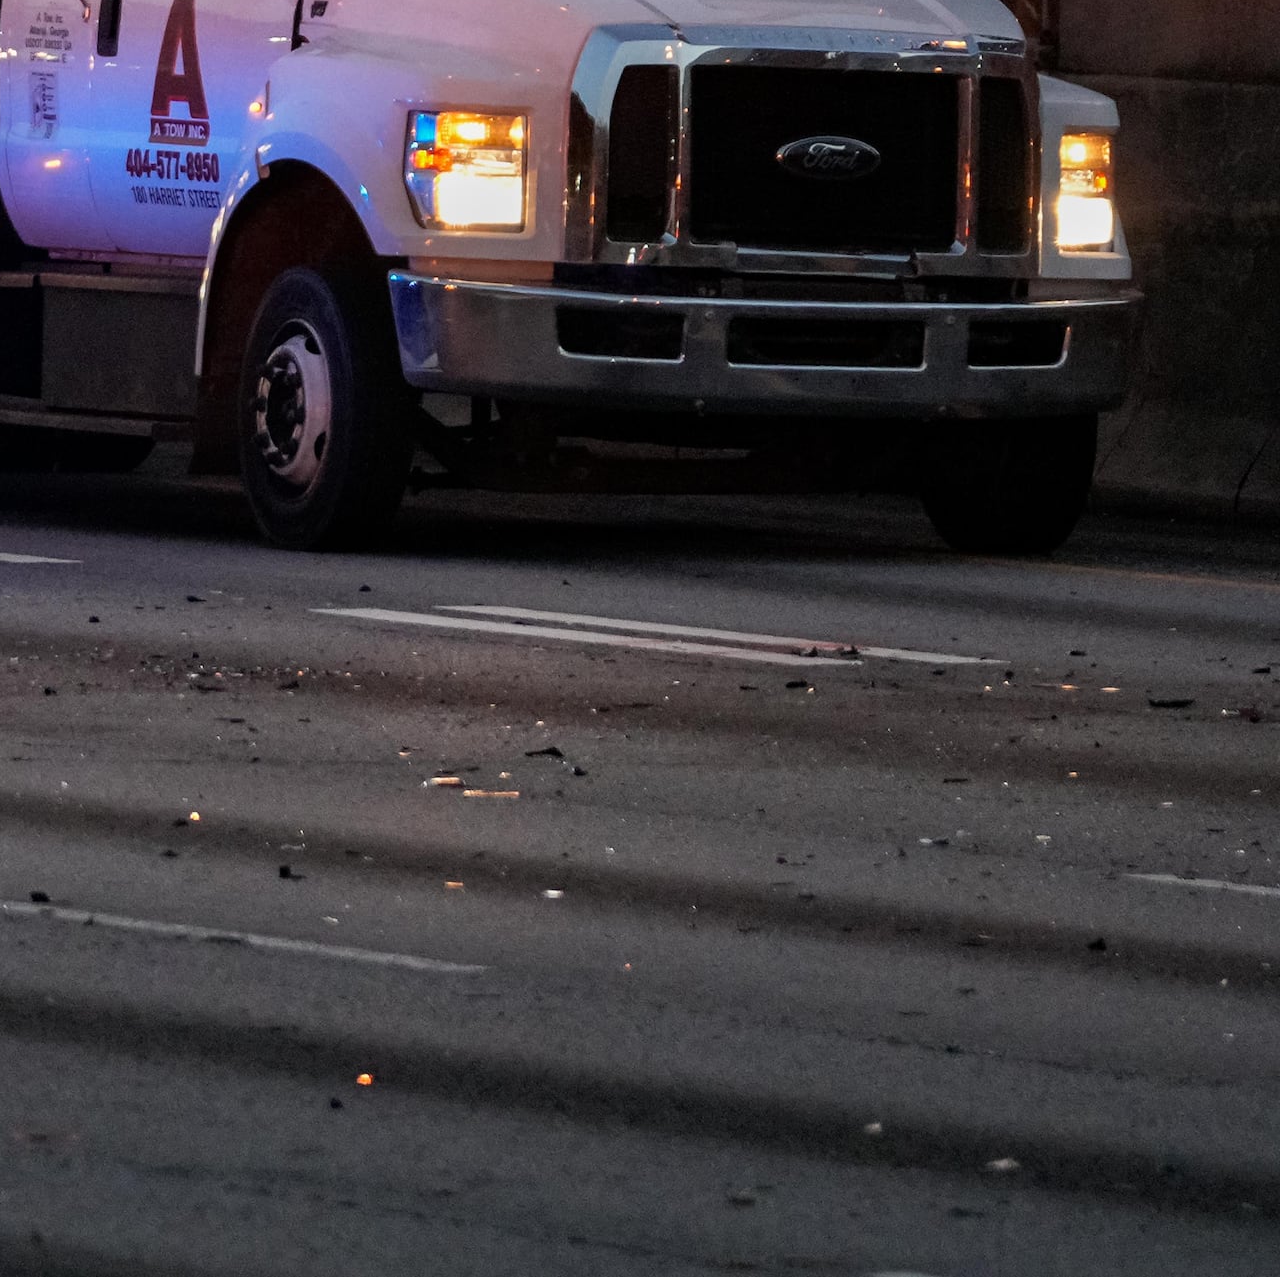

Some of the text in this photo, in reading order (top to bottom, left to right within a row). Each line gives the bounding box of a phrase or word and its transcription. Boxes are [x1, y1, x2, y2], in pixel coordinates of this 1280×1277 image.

[153, 123, 206, 140] A TOW INC.
[126, 148, 220, 183] 404-577-8950
[803, 142, 860, 170] Ford
[131, 186, 220, 209] 180 HARRIET STREET
